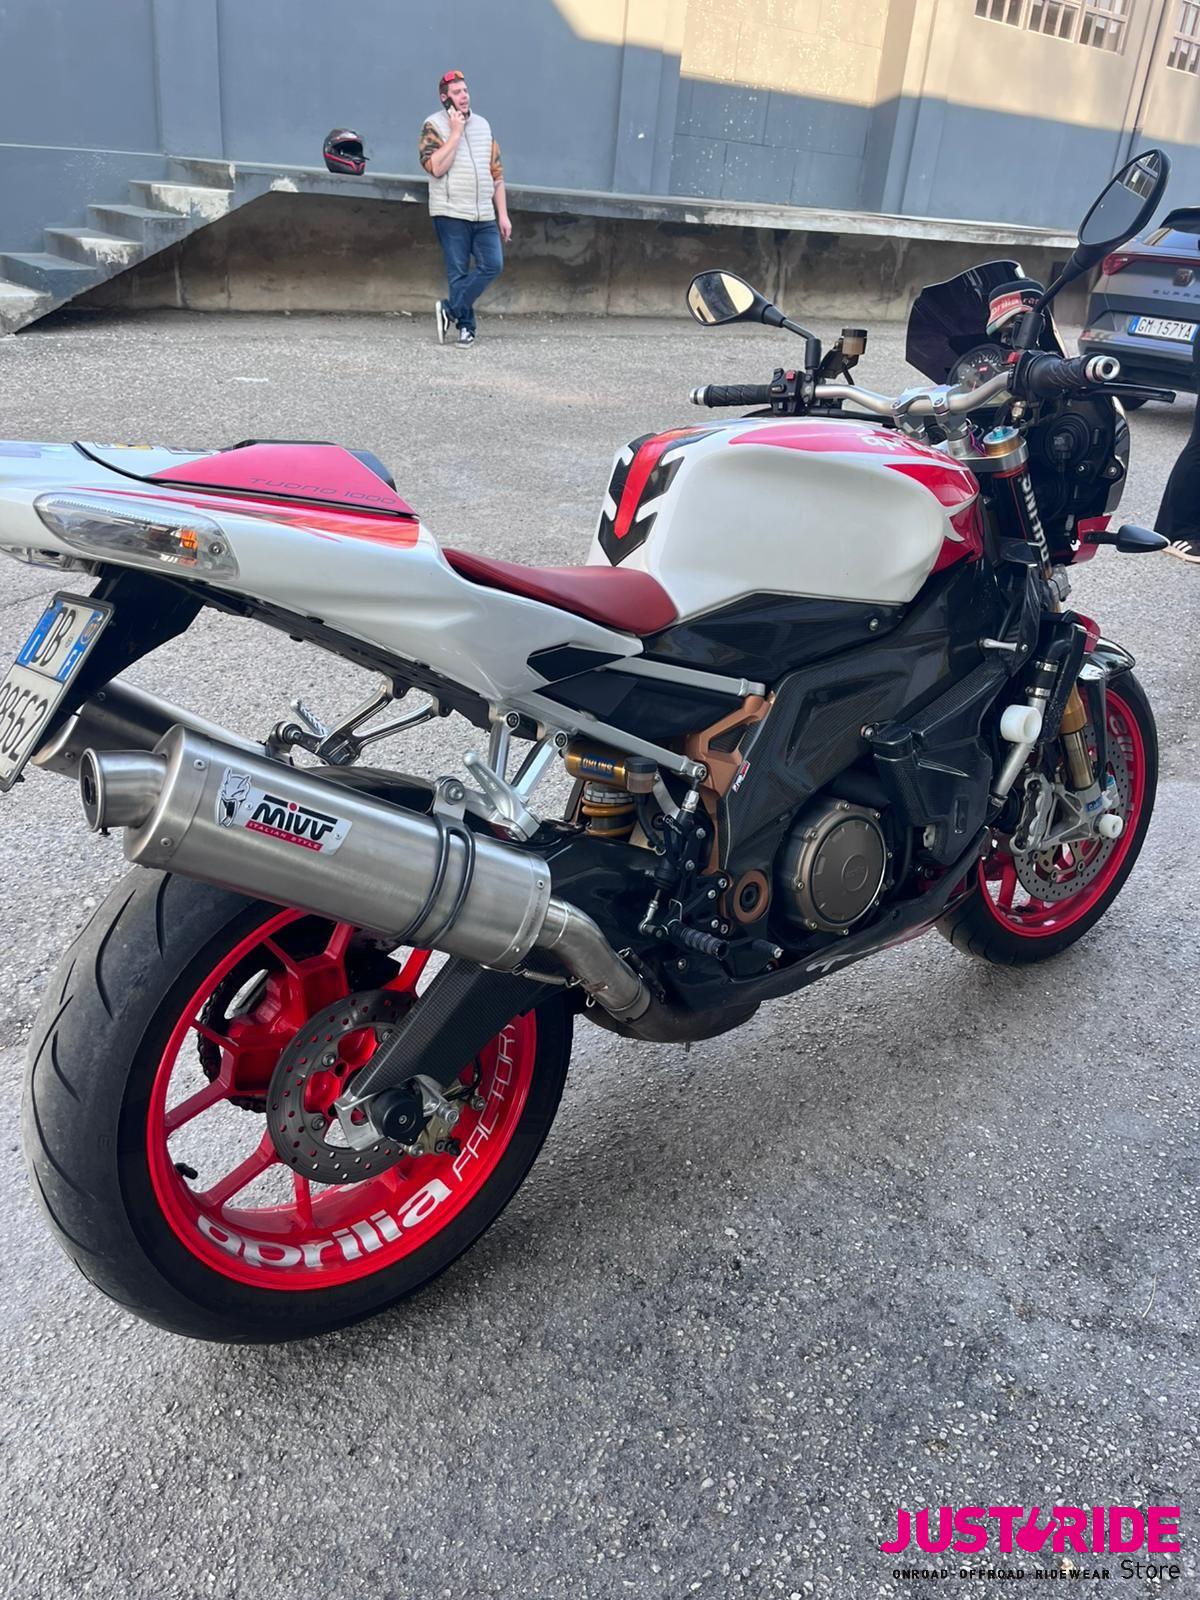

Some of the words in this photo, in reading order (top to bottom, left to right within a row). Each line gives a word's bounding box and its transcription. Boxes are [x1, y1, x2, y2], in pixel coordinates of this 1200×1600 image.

[1137, 319, 1155, 335] GM
[1157, 321, 1193, 340] 157YA
[343, 491, 397, 505] 1000
[31, 606, 77, 668] DB
[249, 821, 288, 839] ITALIAN
[291, 834, 322, 851] STYLE
[198, 1178, 453, 1268] aprilia
